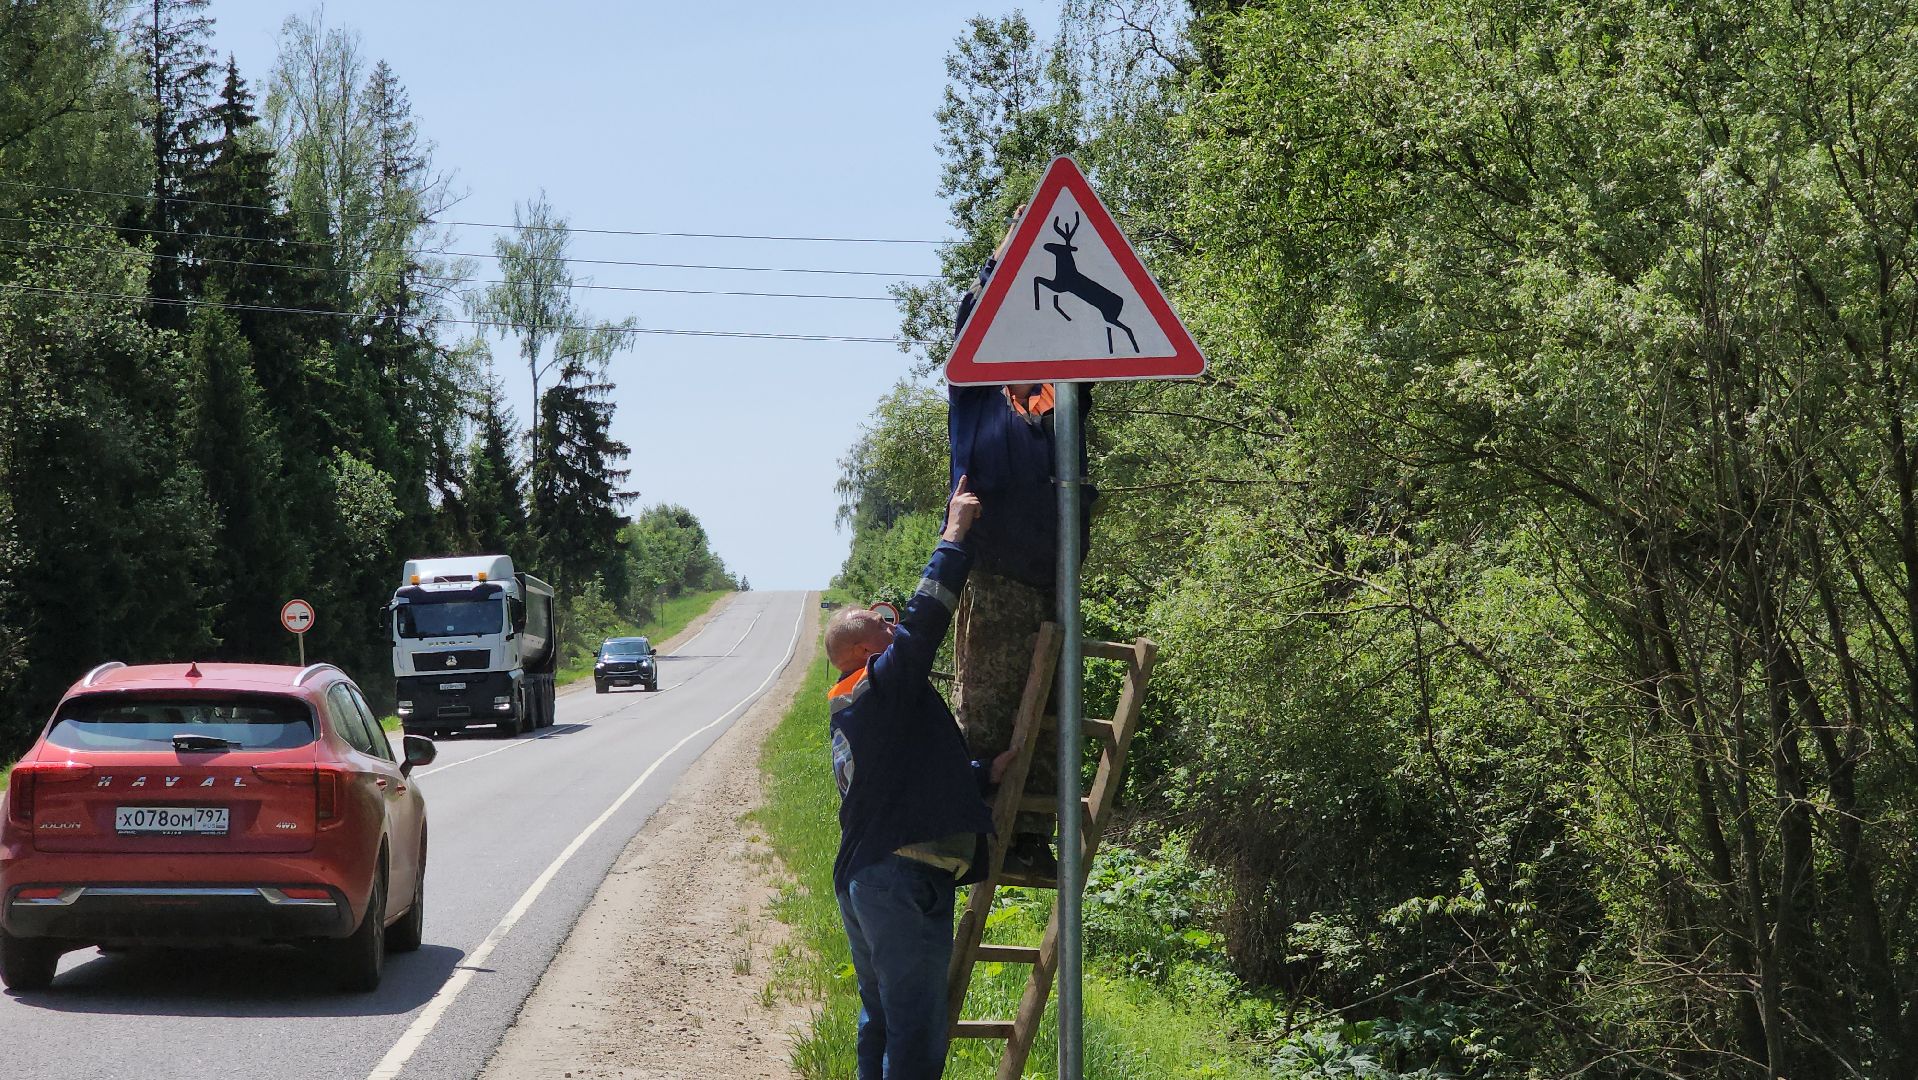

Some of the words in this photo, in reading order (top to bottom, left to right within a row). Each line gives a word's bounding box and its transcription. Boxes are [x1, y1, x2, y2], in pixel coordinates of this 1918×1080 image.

[97, 776, 247, 787] HAVAL
[197, 810, 223, 822] 797
[276, 821, 297, 829] 4WD
